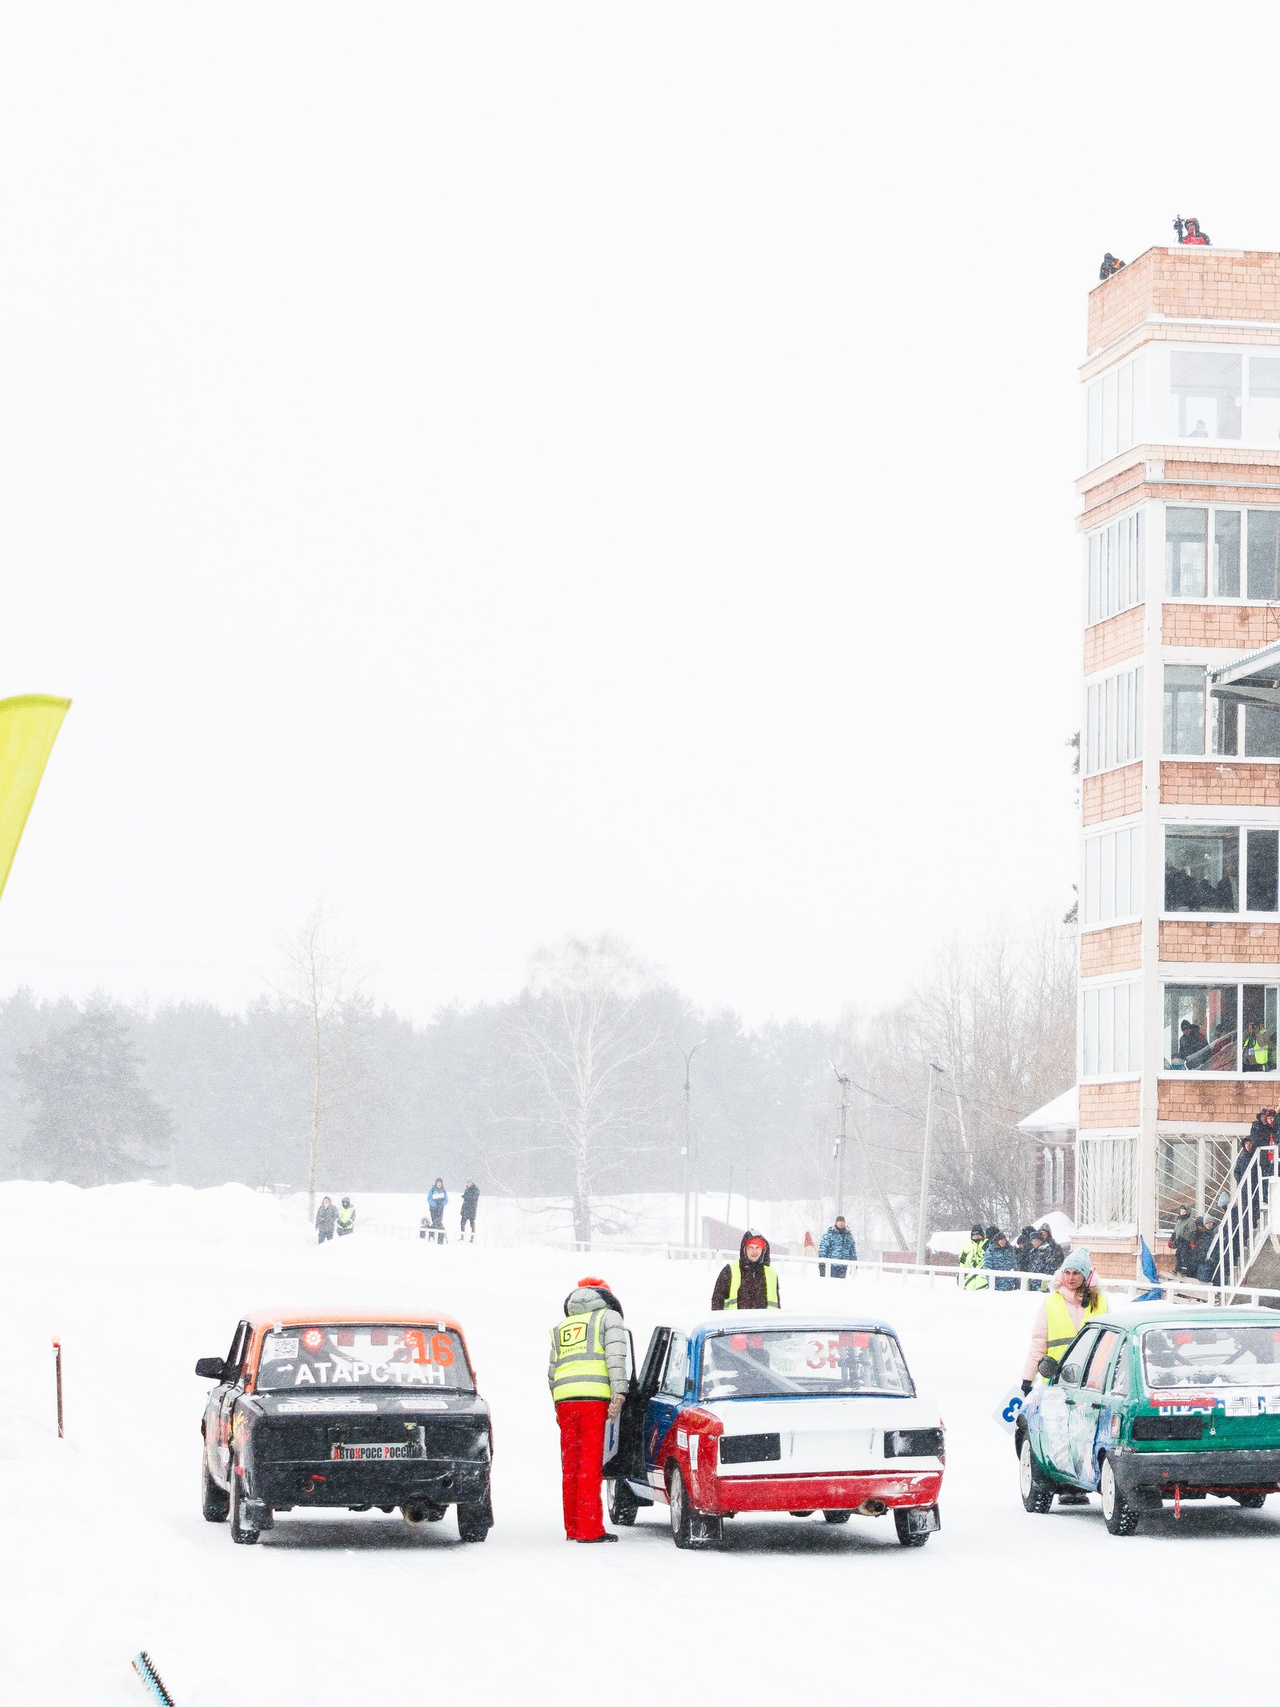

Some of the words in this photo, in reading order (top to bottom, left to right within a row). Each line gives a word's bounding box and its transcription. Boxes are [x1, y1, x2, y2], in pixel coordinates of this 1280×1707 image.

[412, 1331, 455, 1367] 16
[277, 1362, 446, 1385] АТАРСТАН
[1002, 1397, 1023, 1423] 3
[333, 1446, 383, 1460] АВТОКРОСС
